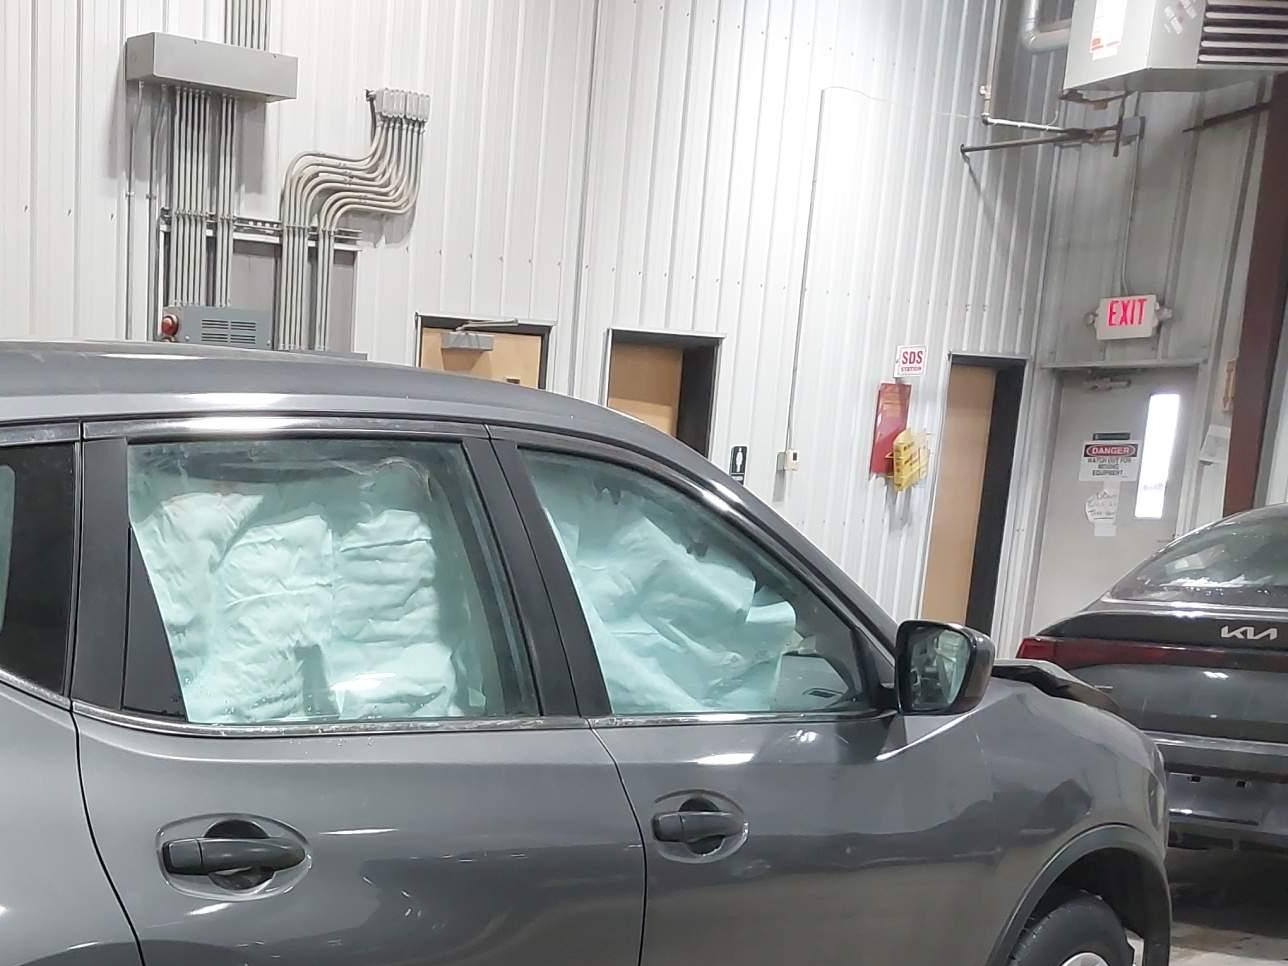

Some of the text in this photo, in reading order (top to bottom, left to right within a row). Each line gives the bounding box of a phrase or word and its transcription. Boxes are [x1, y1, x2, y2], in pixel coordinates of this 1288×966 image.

[1108, 298, 1148, 326] EXIT
[901, 350, 923, 365] SDS
[1092, 447, 1129, 455] DANGER
[1220, 625, 1278, 641] KIA
